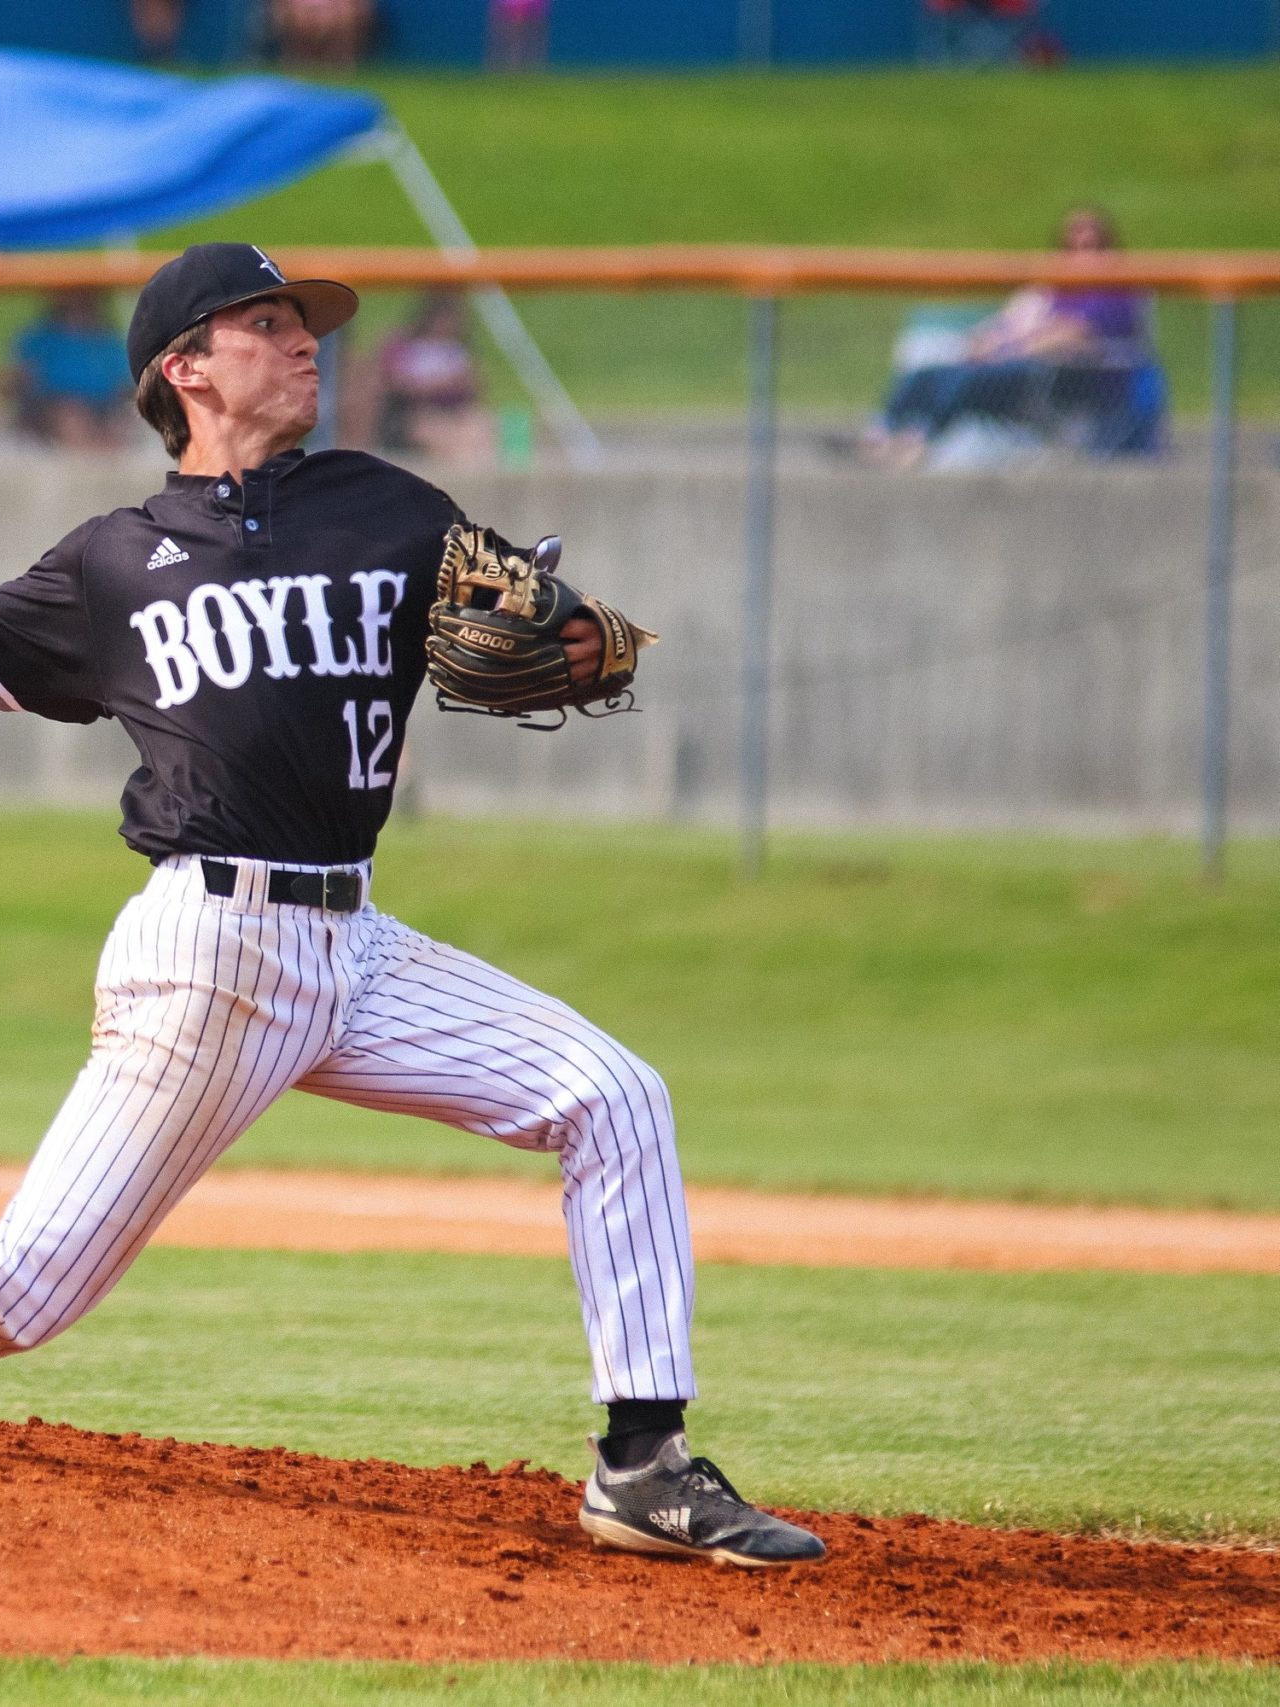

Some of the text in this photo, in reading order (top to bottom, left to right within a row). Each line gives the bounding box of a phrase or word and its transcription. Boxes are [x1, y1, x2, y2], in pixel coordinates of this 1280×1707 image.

[147, 551, 190, 570] adidas
[129, 569, 409, 709] BOYLE
[458, 626, 516, 651] A2000
[342, 699, 393, 790] 12
